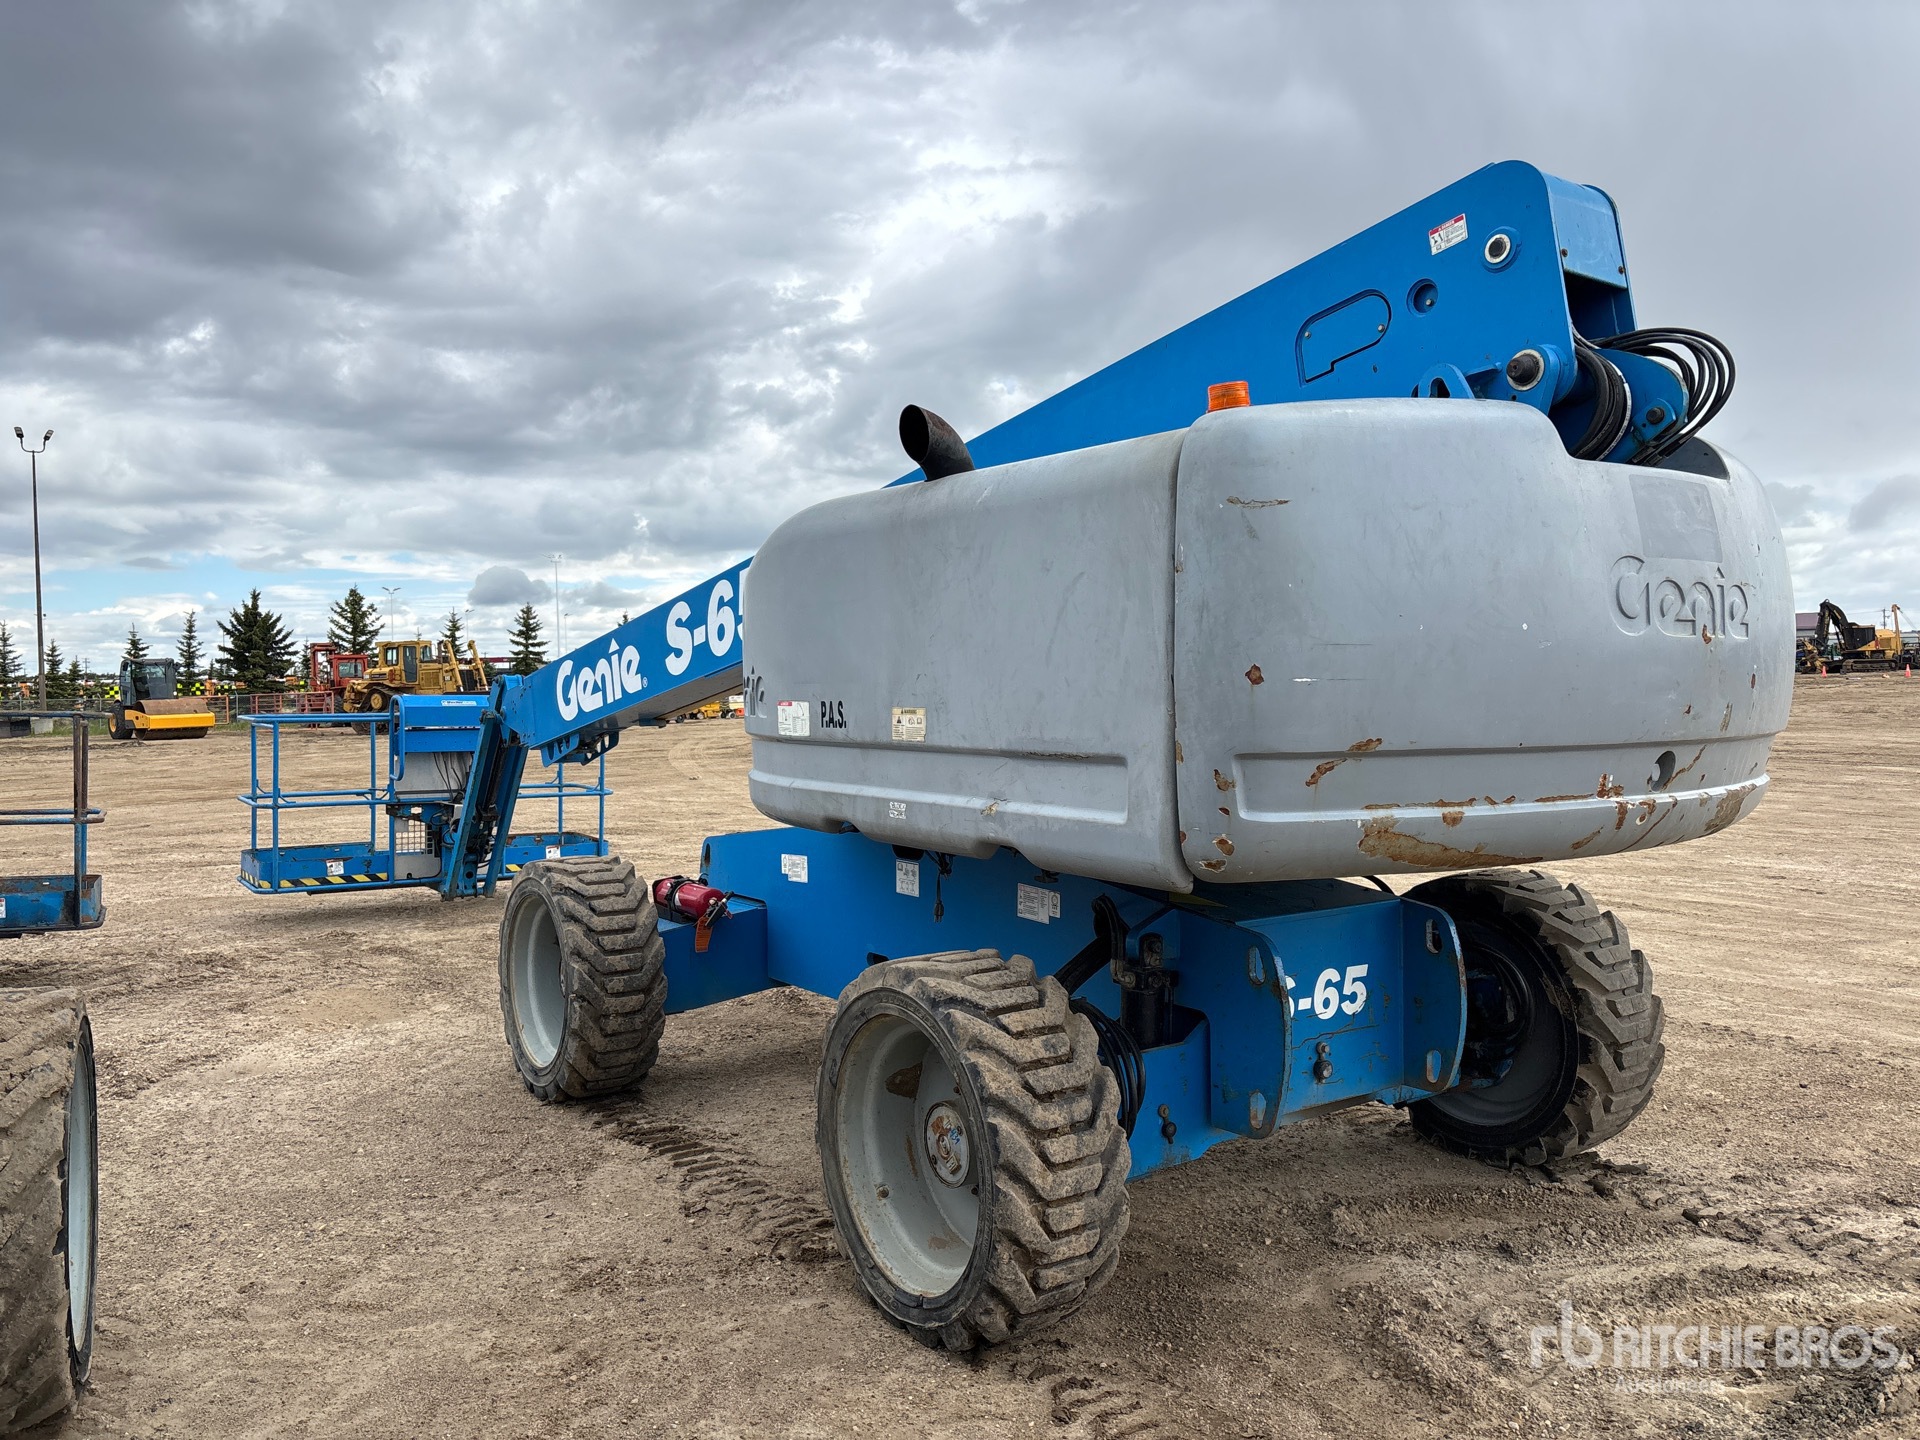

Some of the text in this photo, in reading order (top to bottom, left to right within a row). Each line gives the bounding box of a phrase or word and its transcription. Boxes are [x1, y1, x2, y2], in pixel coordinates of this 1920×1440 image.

[1609, 555, 1749, 639] Genie
[556, 638, 643, 721] Genie
[820, 700, 847, 728] P.A.S.
